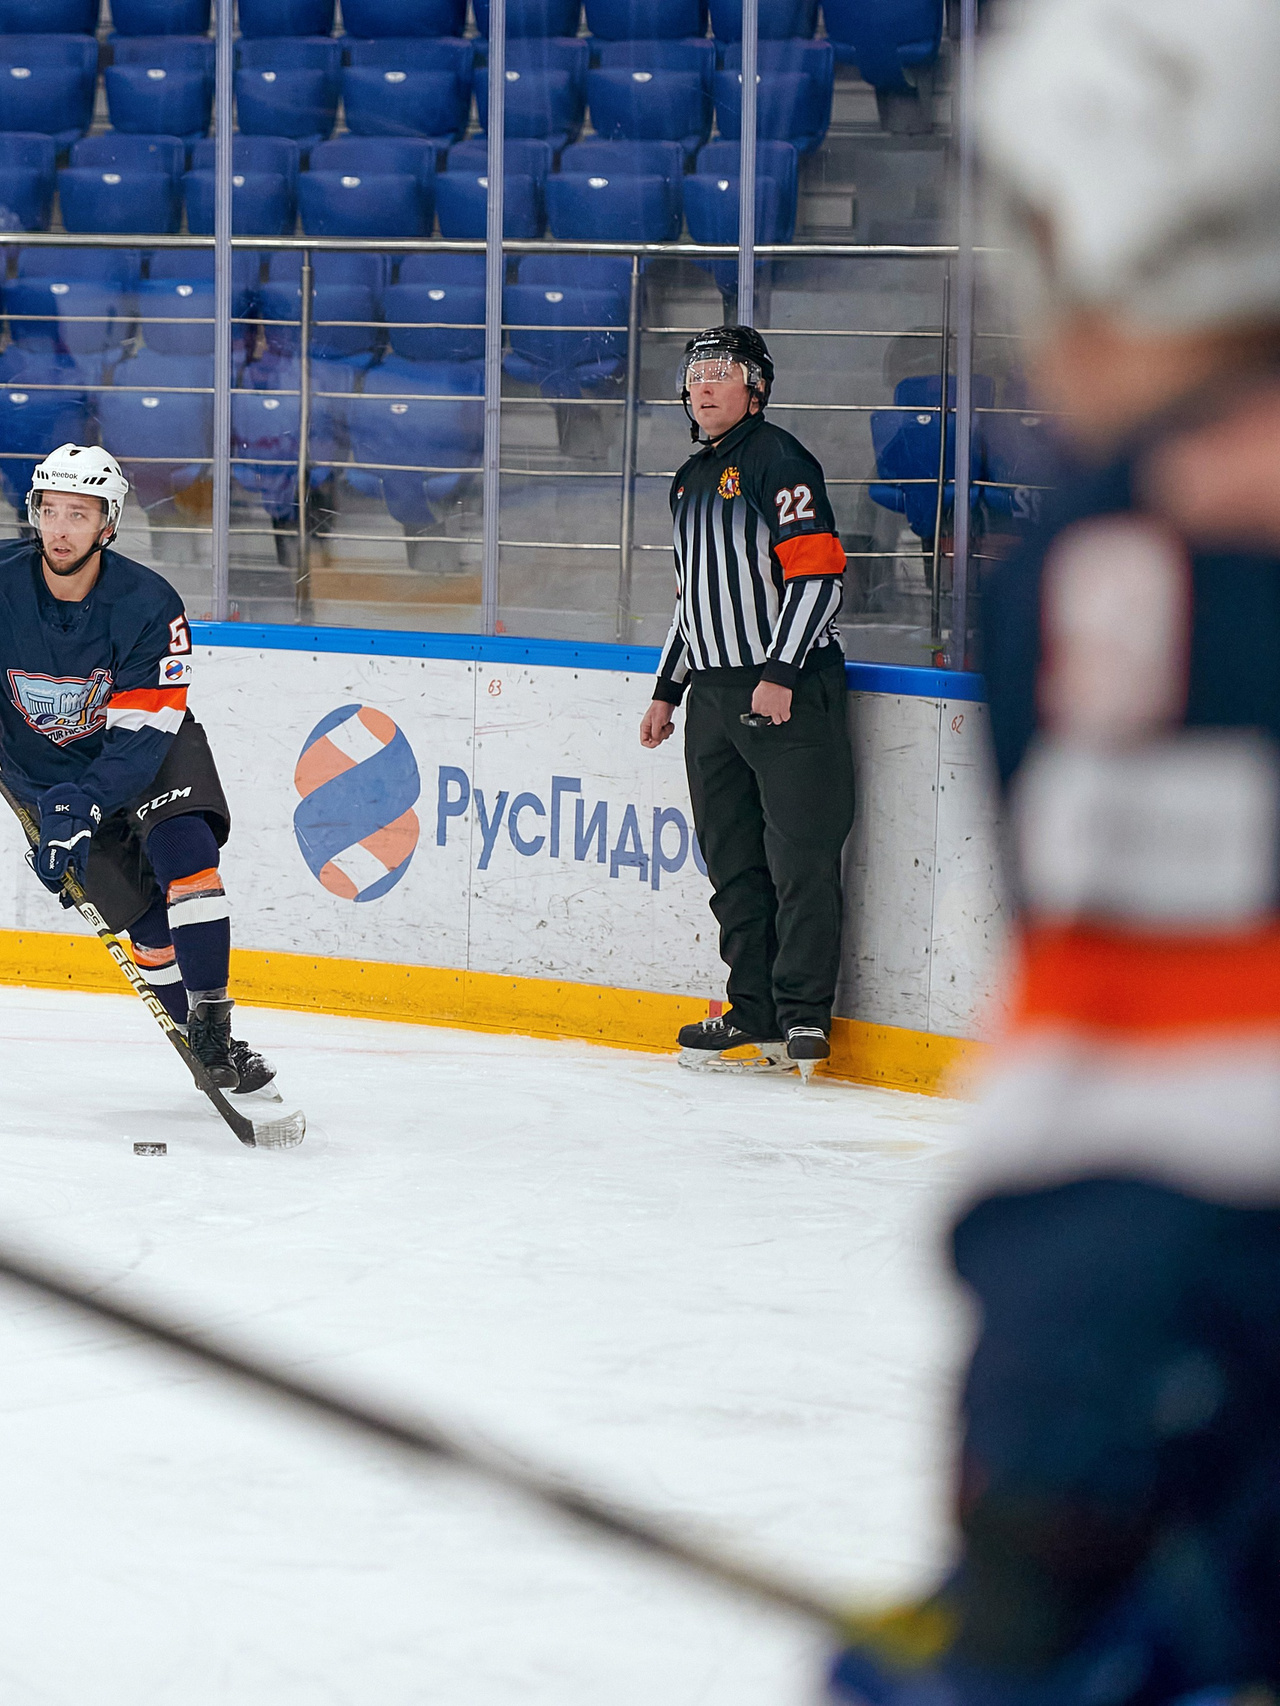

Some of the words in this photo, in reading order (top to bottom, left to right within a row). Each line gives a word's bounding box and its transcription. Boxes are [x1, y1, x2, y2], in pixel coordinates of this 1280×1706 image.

[51, 470, 78, 480] Reebok
[775, 484, 816, 528] 22
[168, 612, 190, 654] 5
[487, 679, 502, 697] 63
[951, 714, 965, 735] 62
[136, 786, 192, 821] CCM
[108, 945, 176, 1035] BAUER
